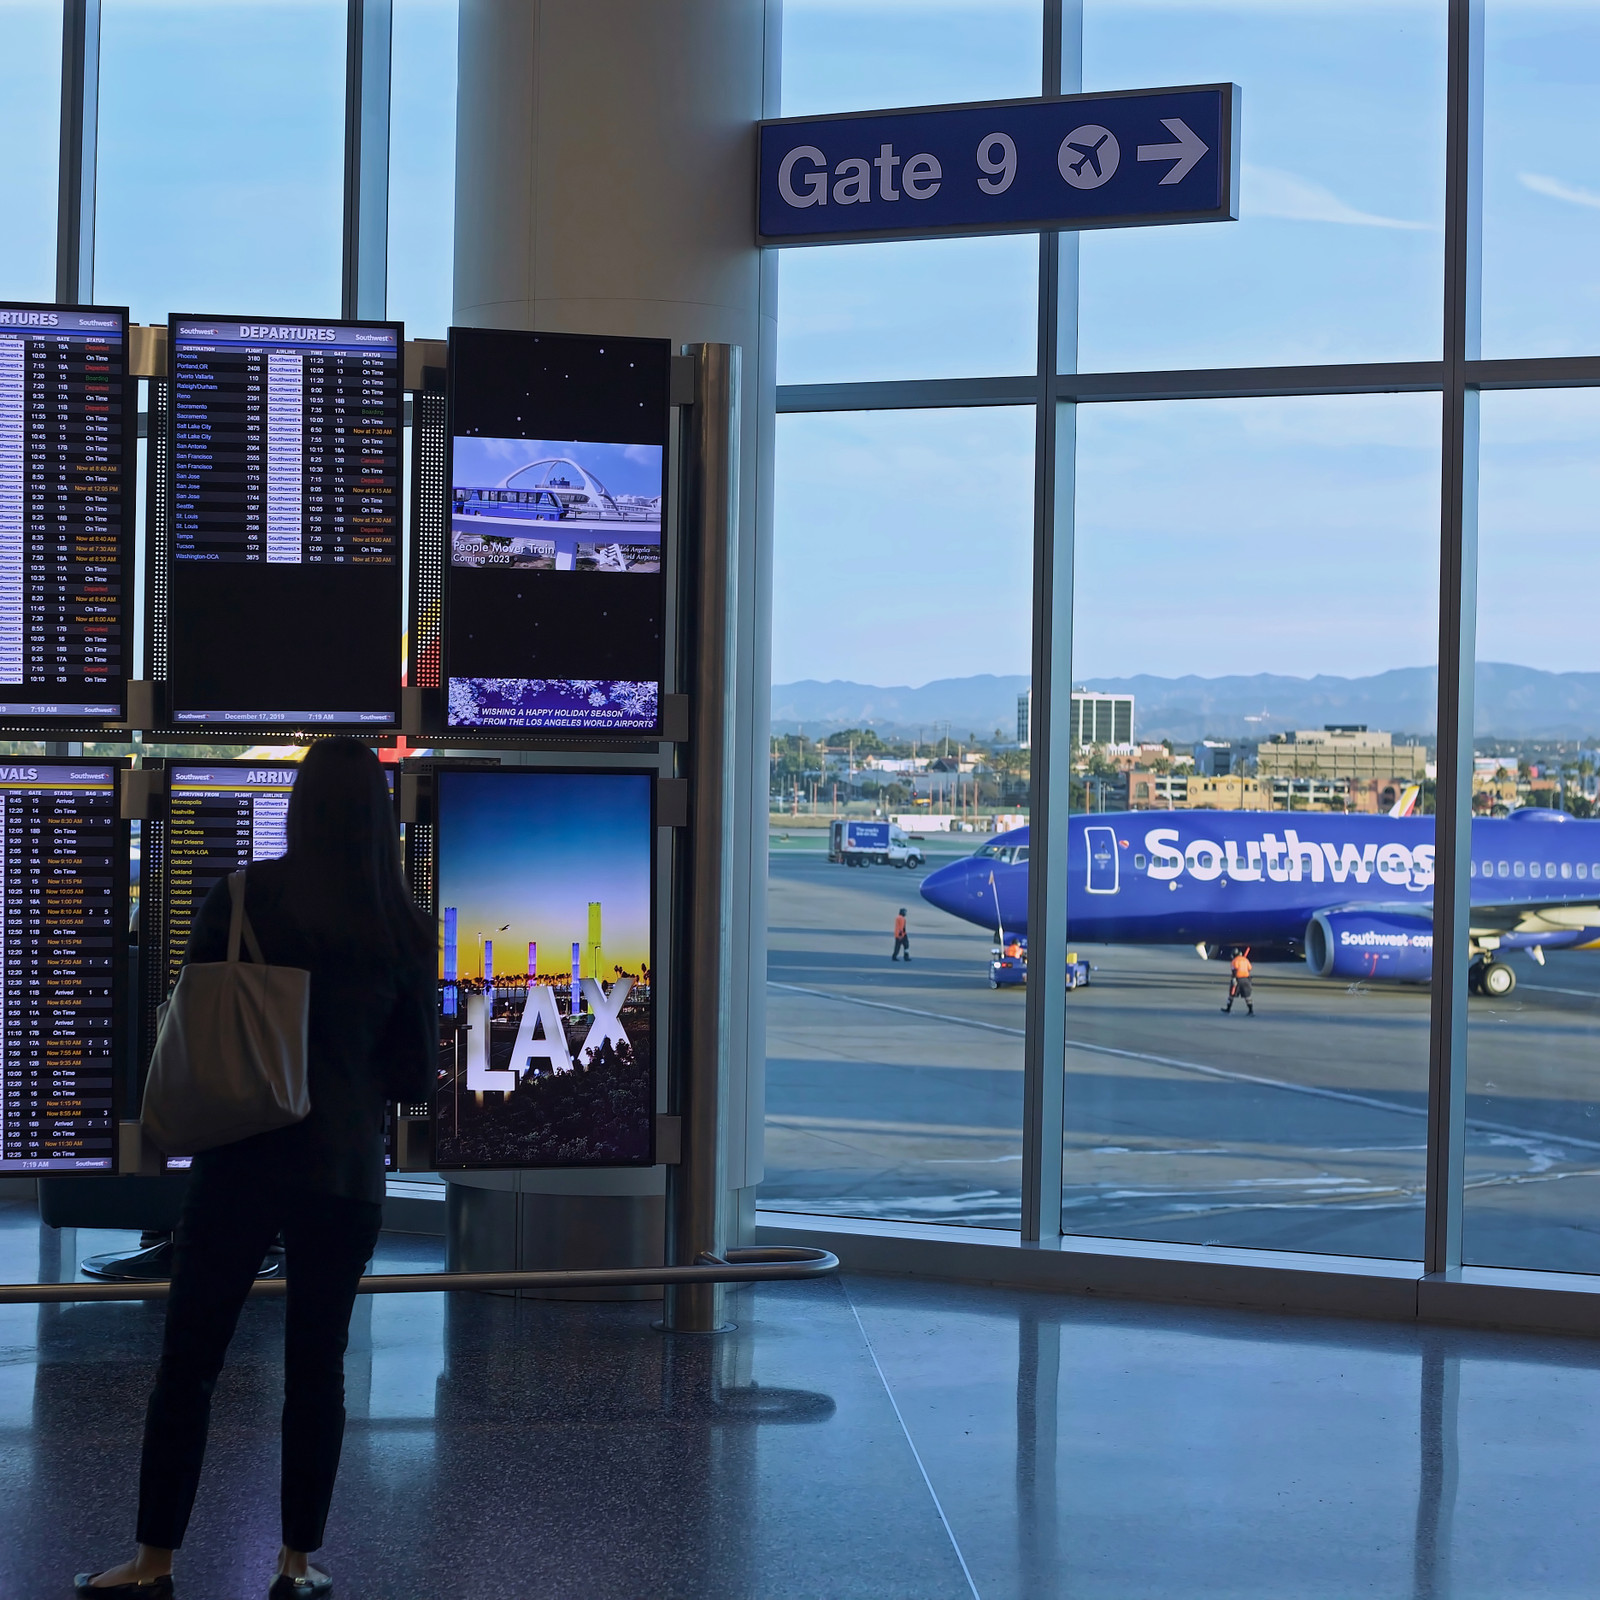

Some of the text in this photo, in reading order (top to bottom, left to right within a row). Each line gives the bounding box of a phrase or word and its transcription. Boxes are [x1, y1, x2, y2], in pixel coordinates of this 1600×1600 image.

[778, 132, 1018, 209] Gate 9
[79, 319, 113, 327] Southwest
[180, 327, 213, 335] Southwest
[239, 326, 336, 341] DEPARTURES
[453, 541, 555, 555] People Mover Train
[630, 546, 651, 555] Angeles
[453, 554, 510, 564] Coming 2023
[257, 713, 267, 721] 17,
[482, 708, 624, 718] WISHING A HAPPY HOLIDAY SEASON
[483, 717, 654, 728] FROM THE LOS ANGELES WORLD AIRPORTS
[70, 772, 104, 780] Southwest
[246, 771, 293, 783] ARRIV
[467, 977, 636, 1091] LAX
